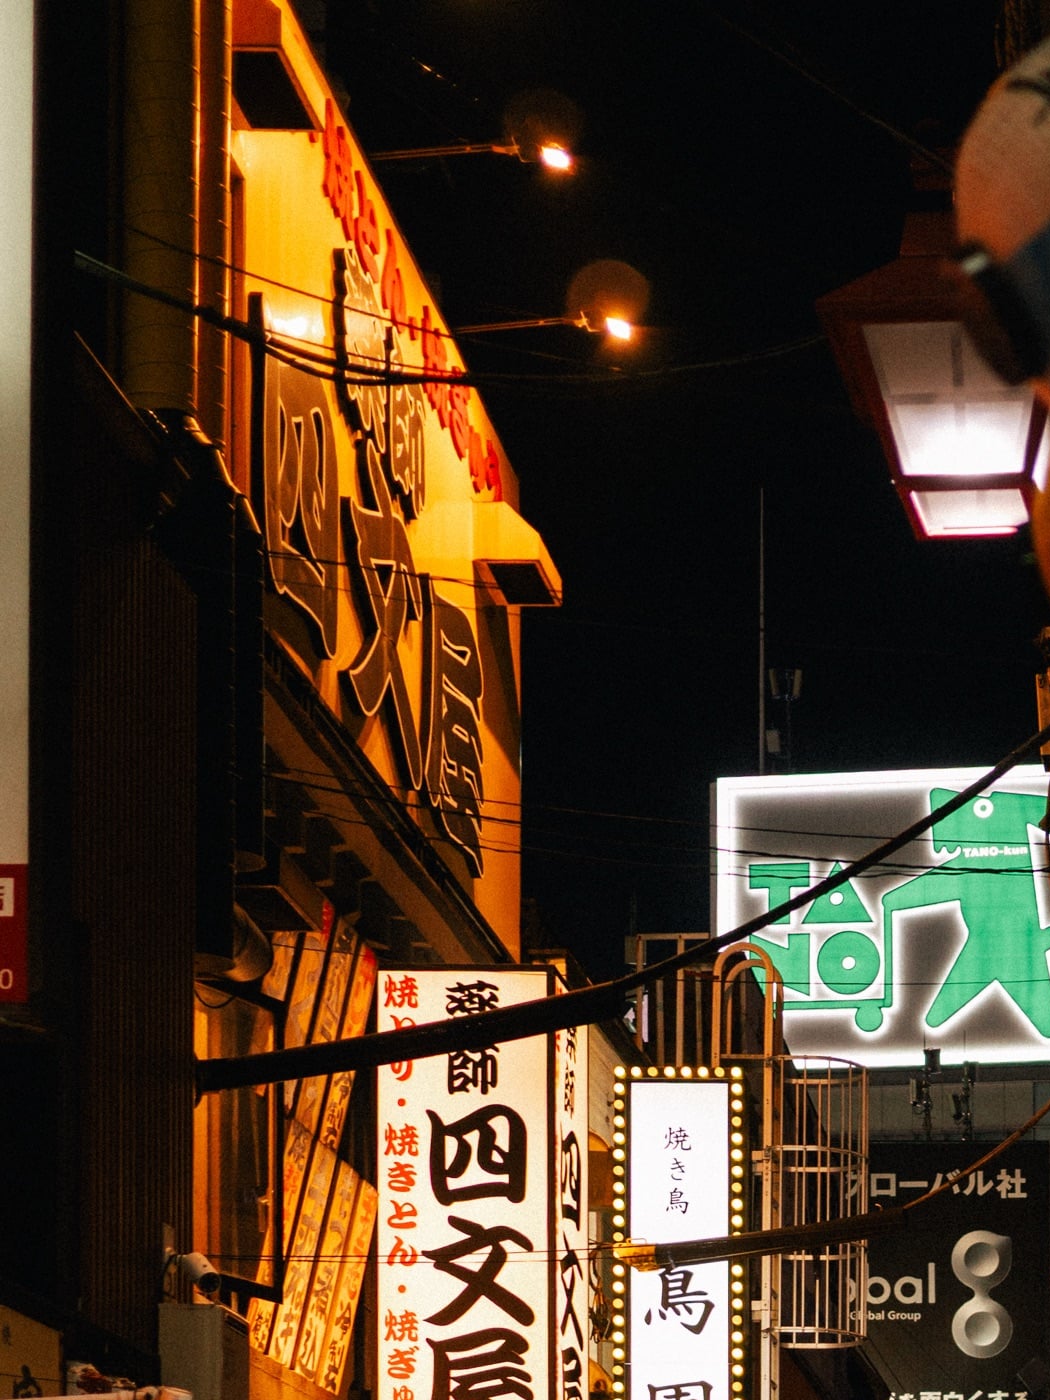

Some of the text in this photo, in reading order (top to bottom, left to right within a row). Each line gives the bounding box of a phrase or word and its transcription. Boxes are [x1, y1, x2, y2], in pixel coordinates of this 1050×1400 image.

[962, 846, 1028, 857] TANO-kun
[664, 1126, 692, 1215] 焼き鳥
[850, 1310, 922, 1322] Glbal Group
